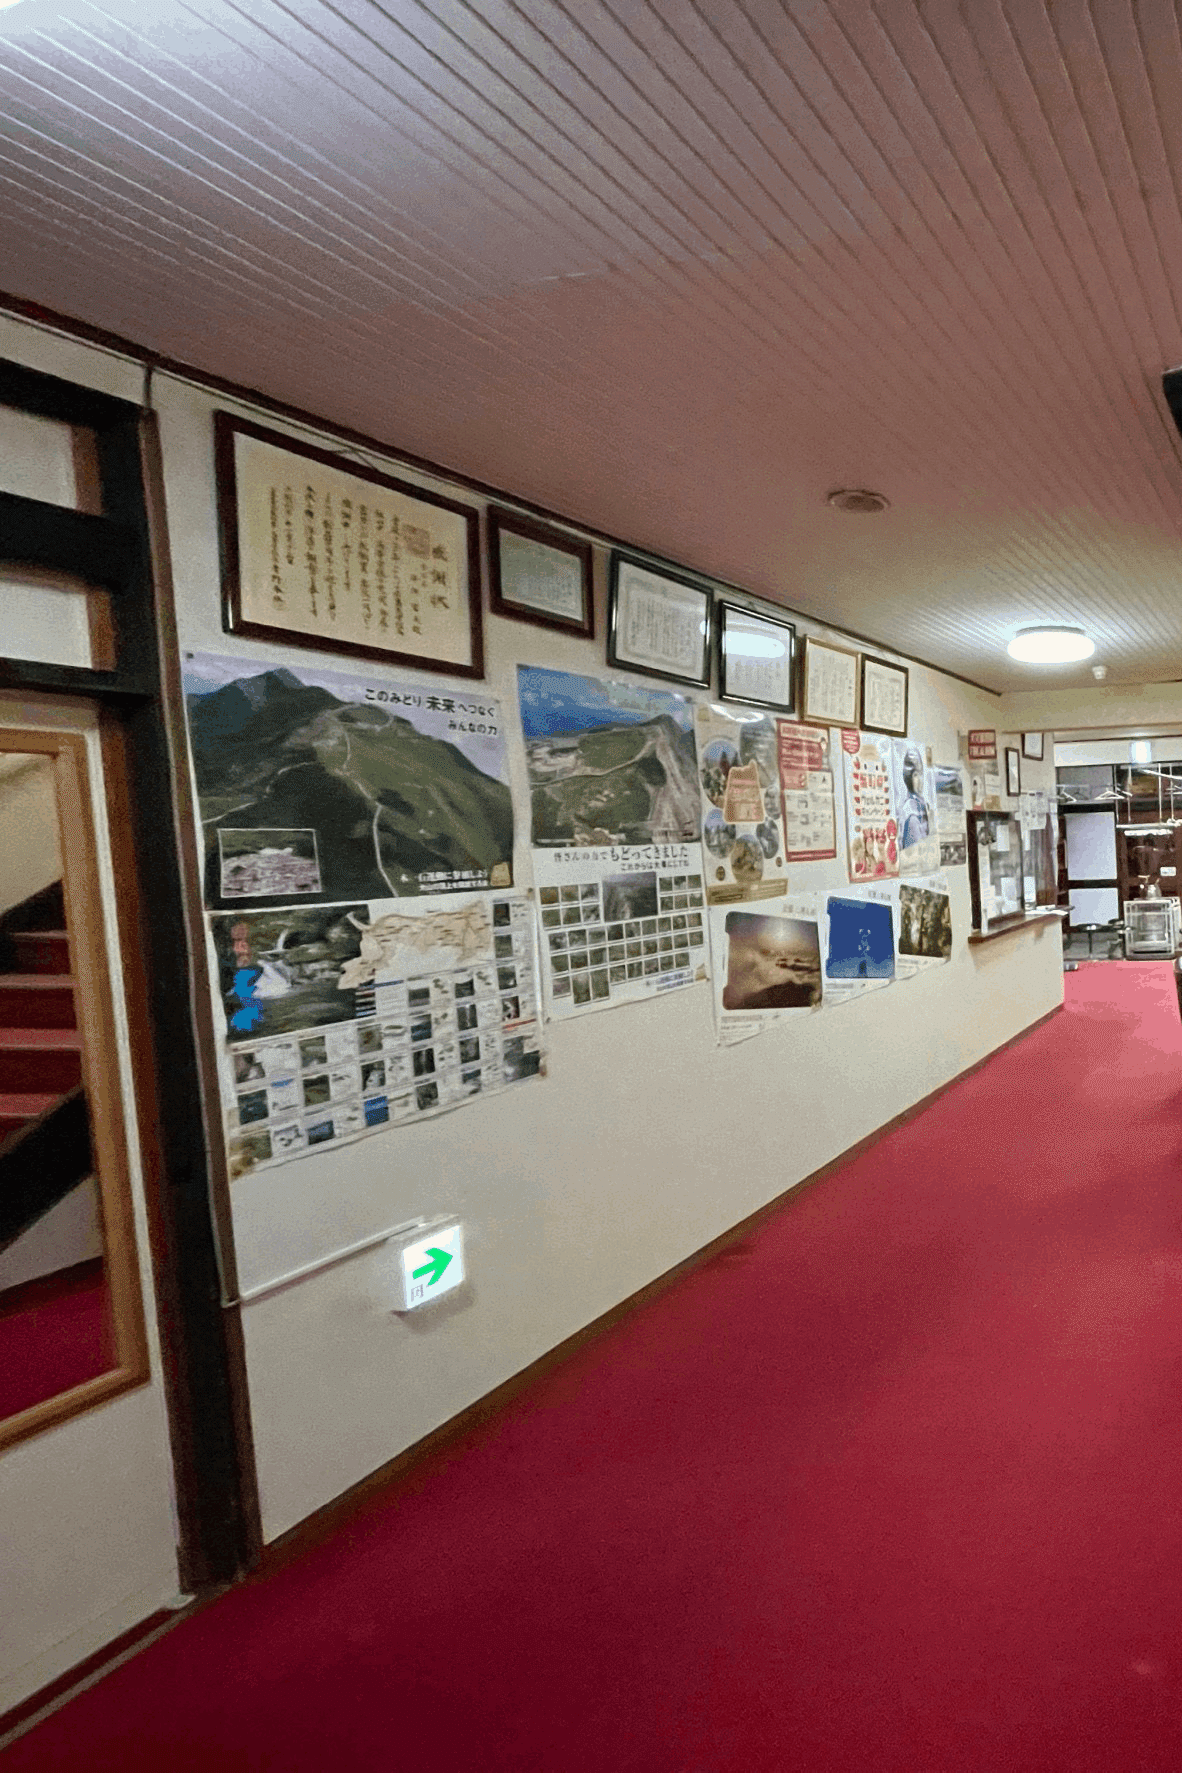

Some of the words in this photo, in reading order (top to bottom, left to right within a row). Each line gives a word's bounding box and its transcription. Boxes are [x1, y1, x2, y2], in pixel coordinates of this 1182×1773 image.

[365, 688, 421, 707] このみどり
